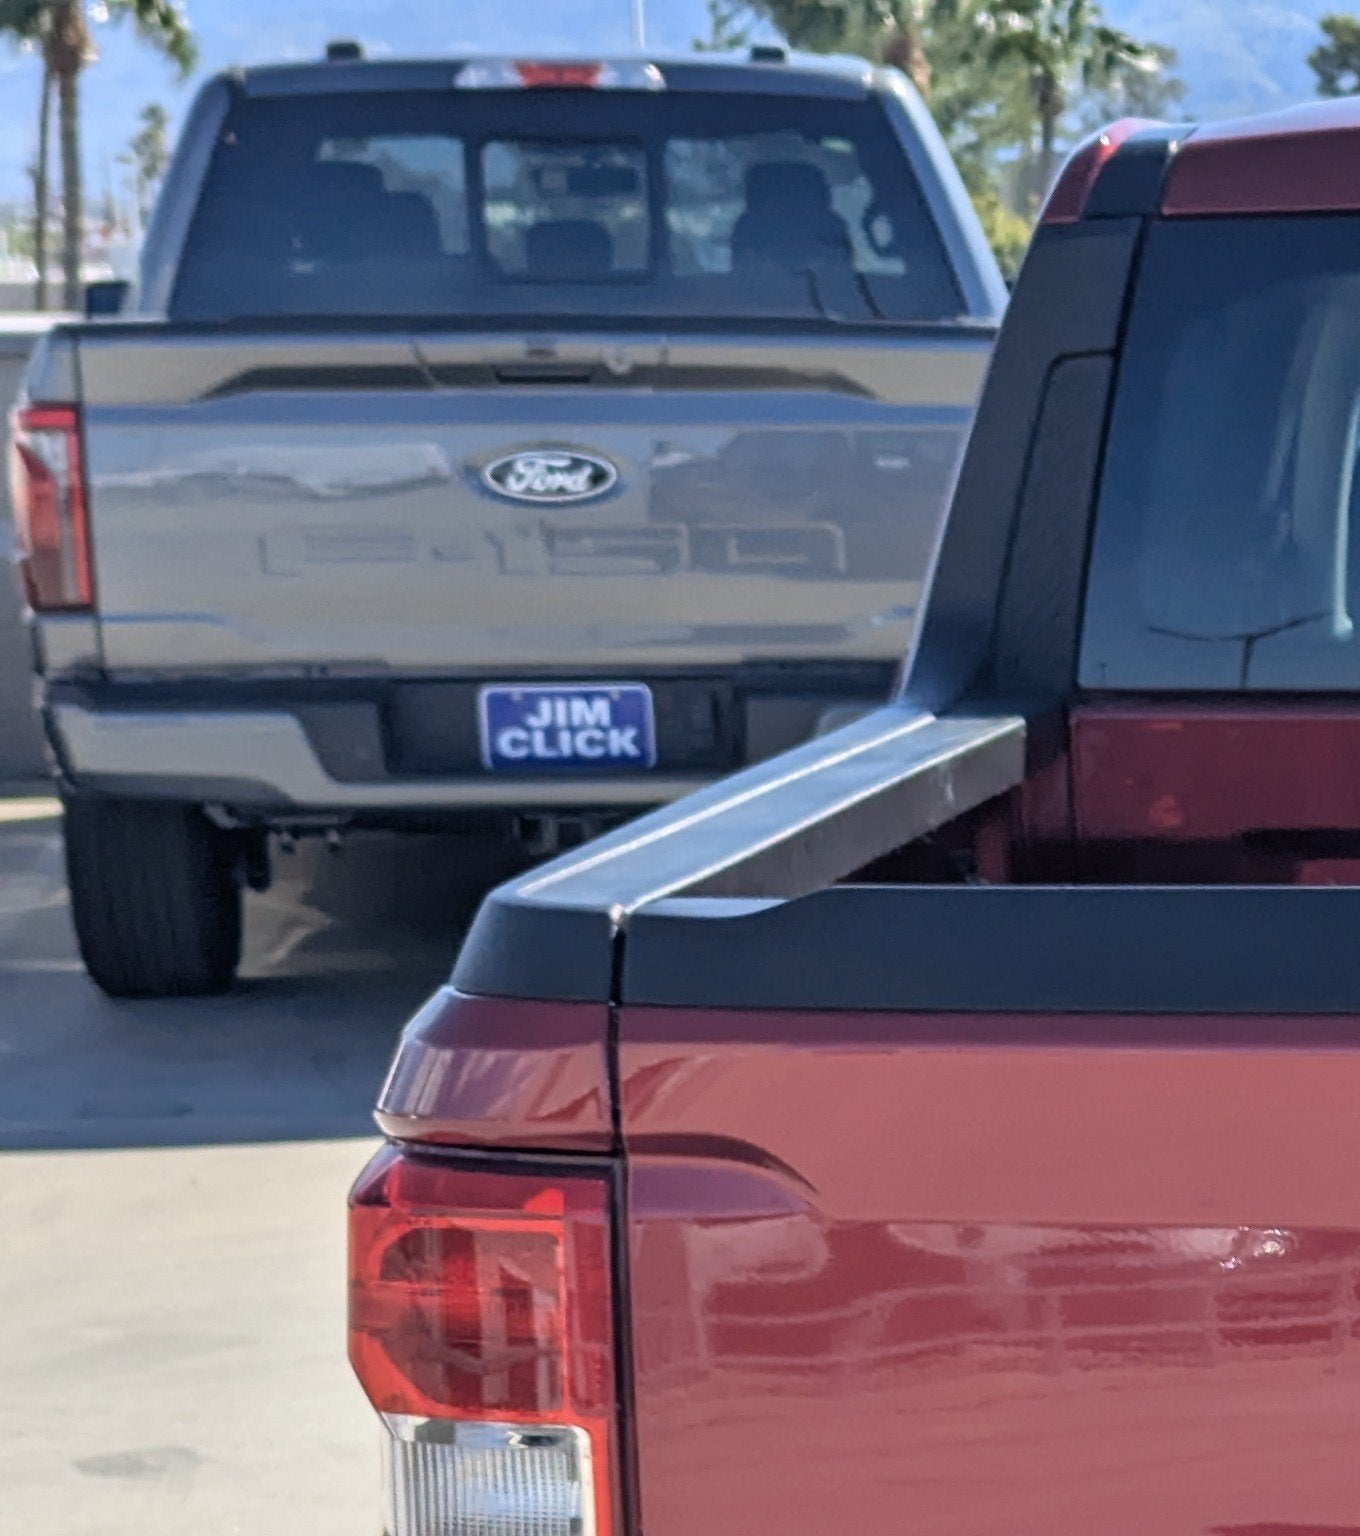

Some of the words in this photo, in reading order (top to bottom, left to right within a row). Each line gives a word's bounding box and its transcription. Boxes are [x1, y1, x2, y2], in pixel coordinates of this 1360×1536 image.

[504, 458, 593, 493] Ford
[523, 697, 612, 728] JIM
[496, 728, 642, 760] CLICK
